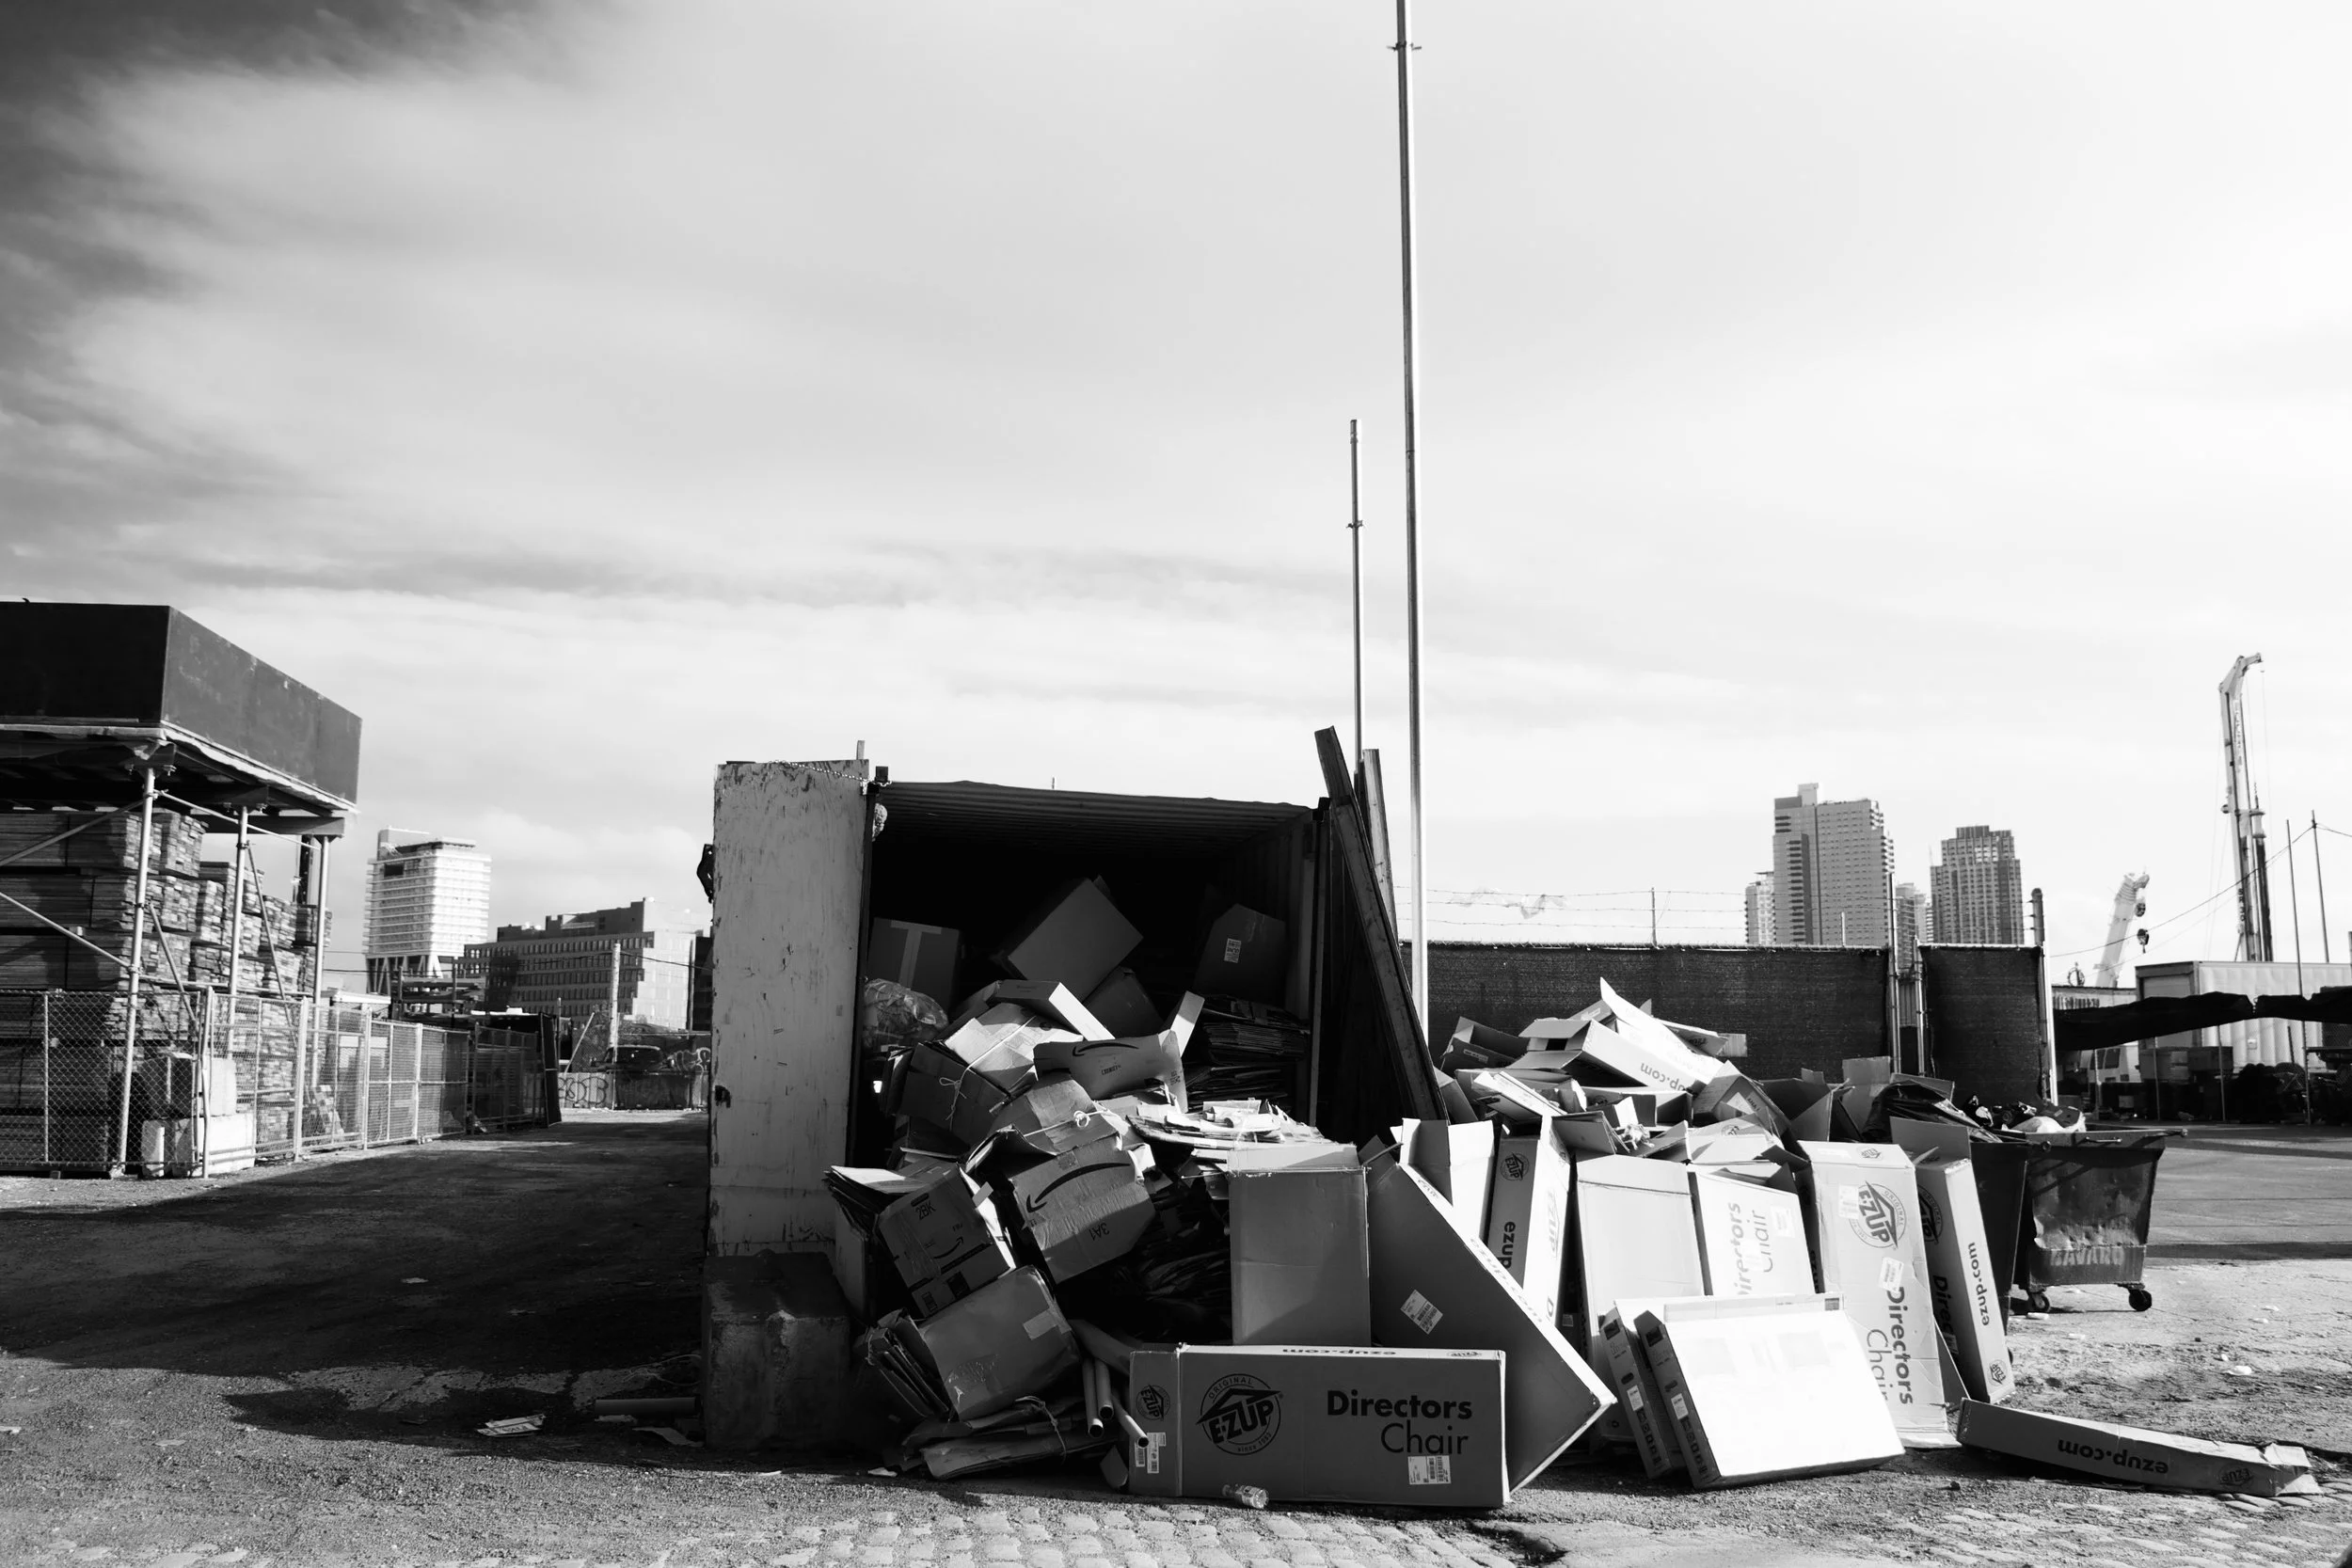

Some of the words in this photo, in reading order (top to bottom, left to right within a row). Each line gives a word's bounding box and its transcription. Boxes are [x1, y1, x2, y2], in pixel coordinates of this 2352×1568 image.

[915, 1200, 936, 1220] 2BK
[1089, 1223, 1110, 1241] 3A1
[1968, 1242, 1990, 1326] ezup.com
[1208, 1376, 1253, 1400] ORIGINAL
[1327, 1388, 1473, 1420] Directors
[1380, 1418, 1470, 1454] Chair
[2058, 1439, 2169, 1475] ezup.com
